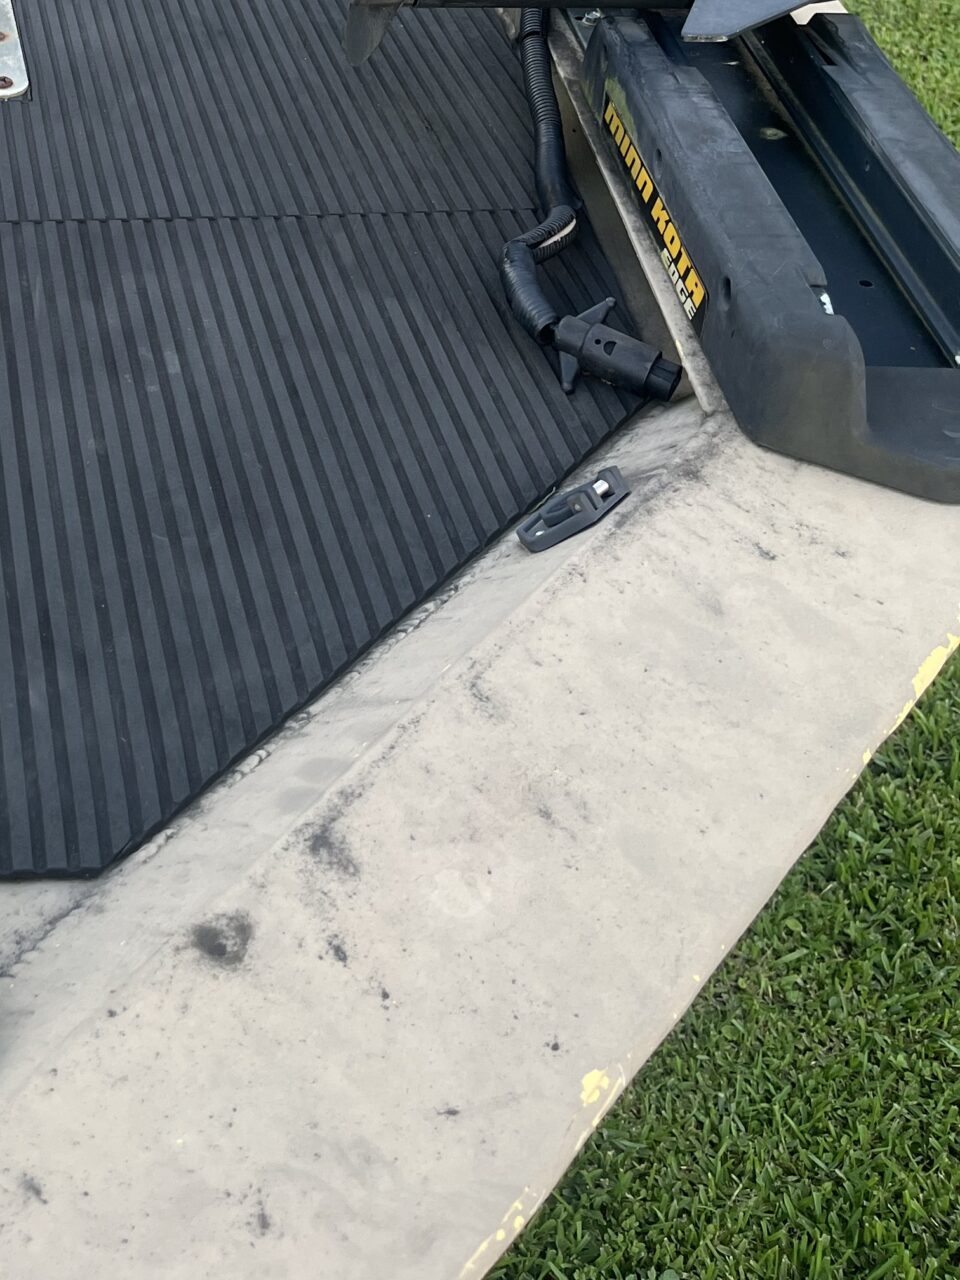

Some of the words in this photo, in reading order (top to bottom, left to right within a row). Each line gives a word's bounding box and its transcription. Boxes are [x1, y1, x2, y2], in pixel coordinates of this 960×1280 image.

[603, 101, 654, 204] MINN
[651, 196, 705, 308] KOTA
[661, 247, 697, 320] EDGE
